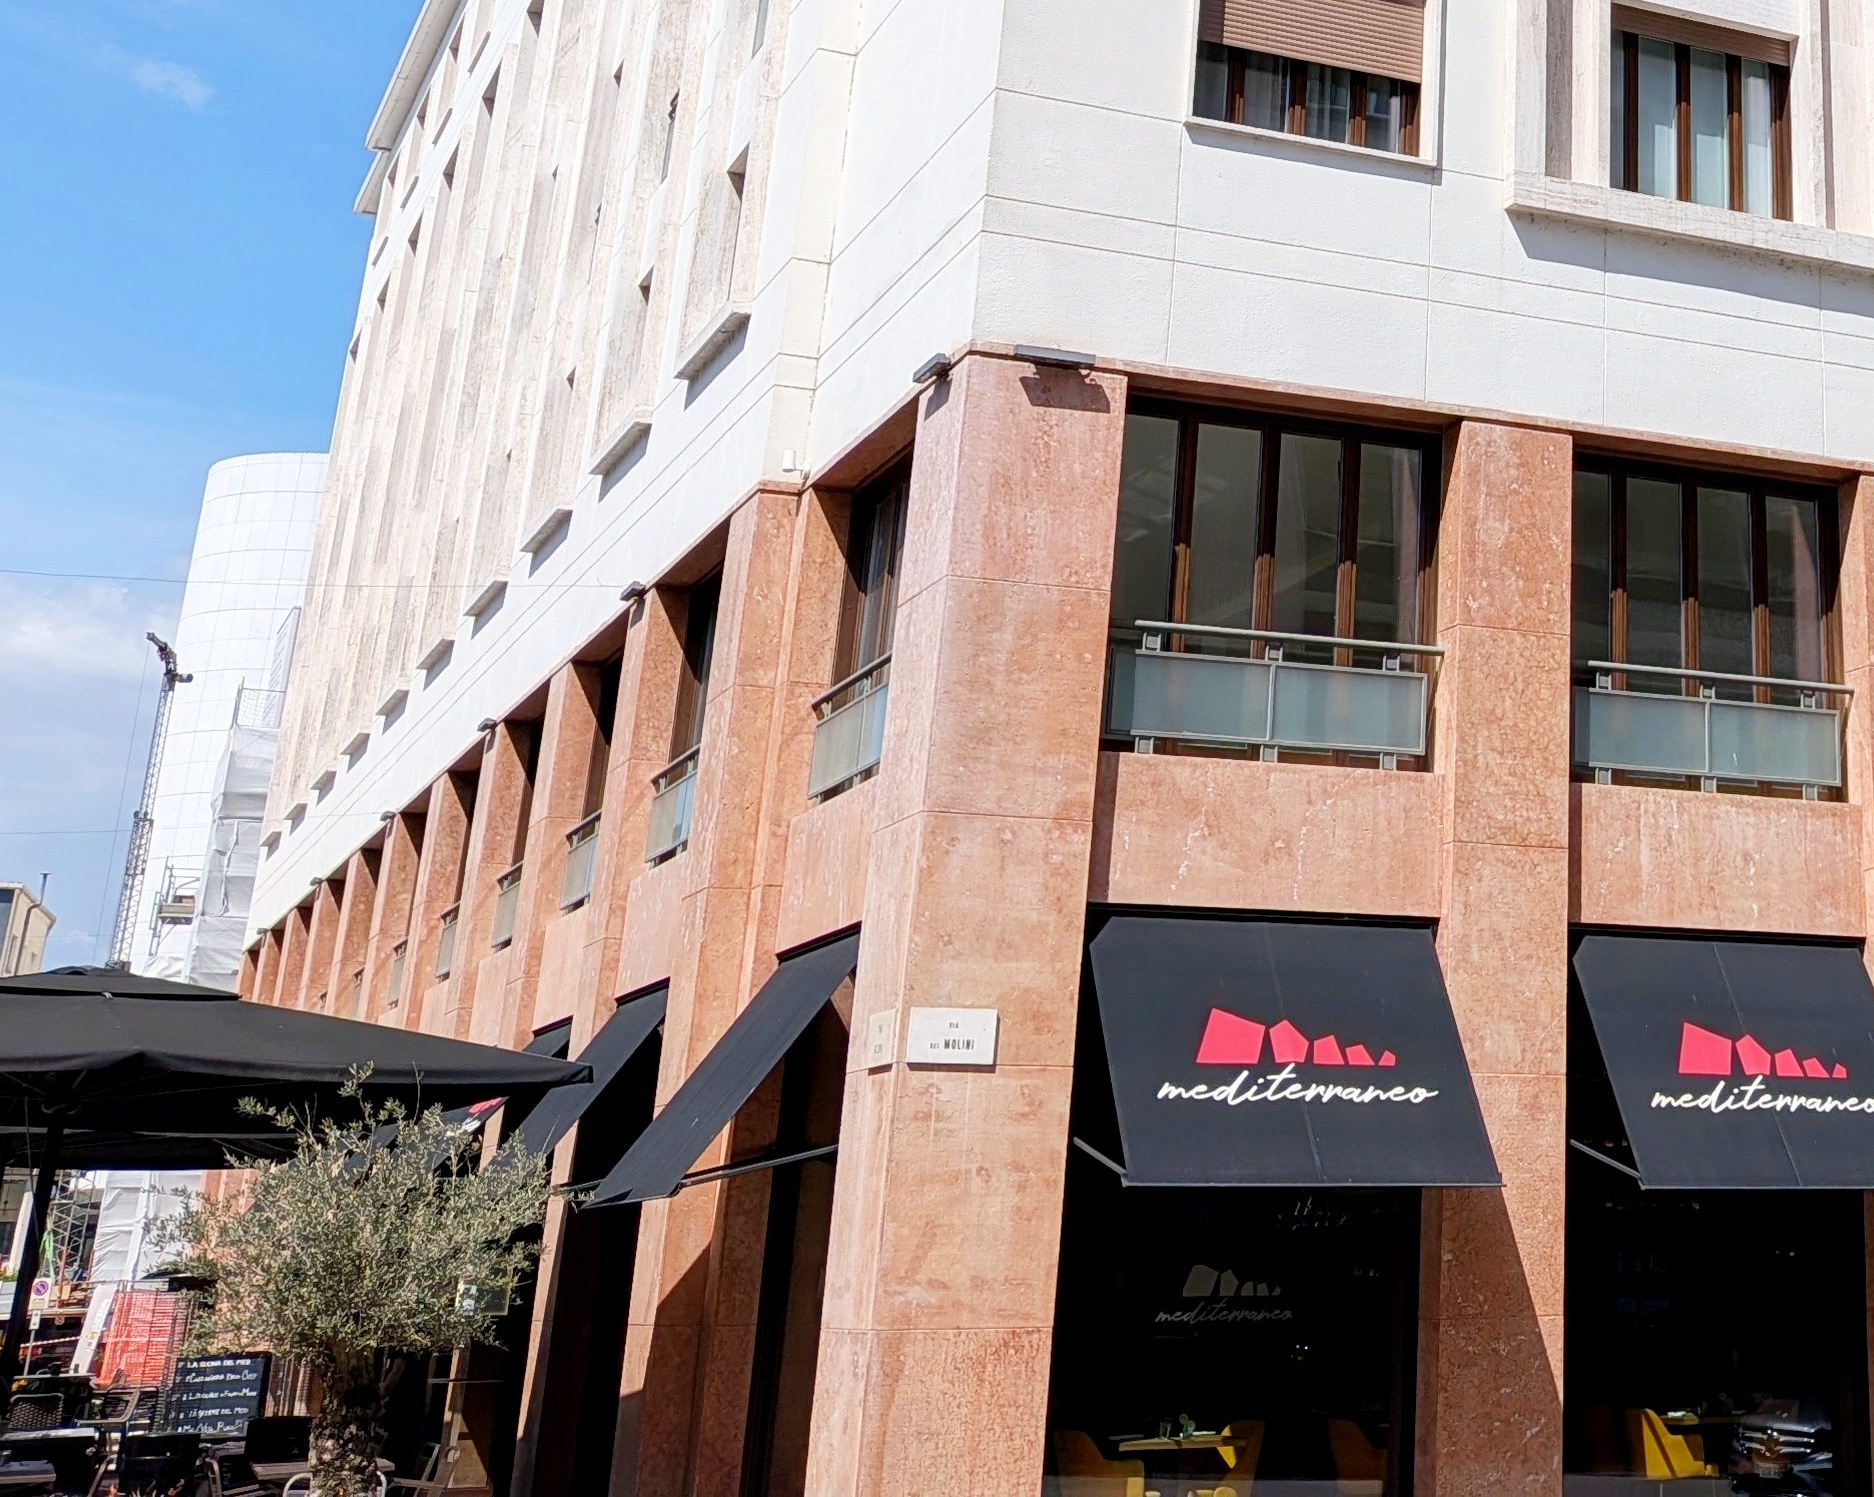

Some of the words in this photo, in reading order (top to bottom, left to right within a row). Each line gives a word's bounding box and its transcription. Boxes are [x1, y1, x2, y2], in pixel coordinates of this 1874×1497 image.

[943, 1039, 975, 1050] MOLINI
[1156, 1063, 1439, 1105] mediterraneo
[1155, 1297, 1292, 1324] mediterraneo
